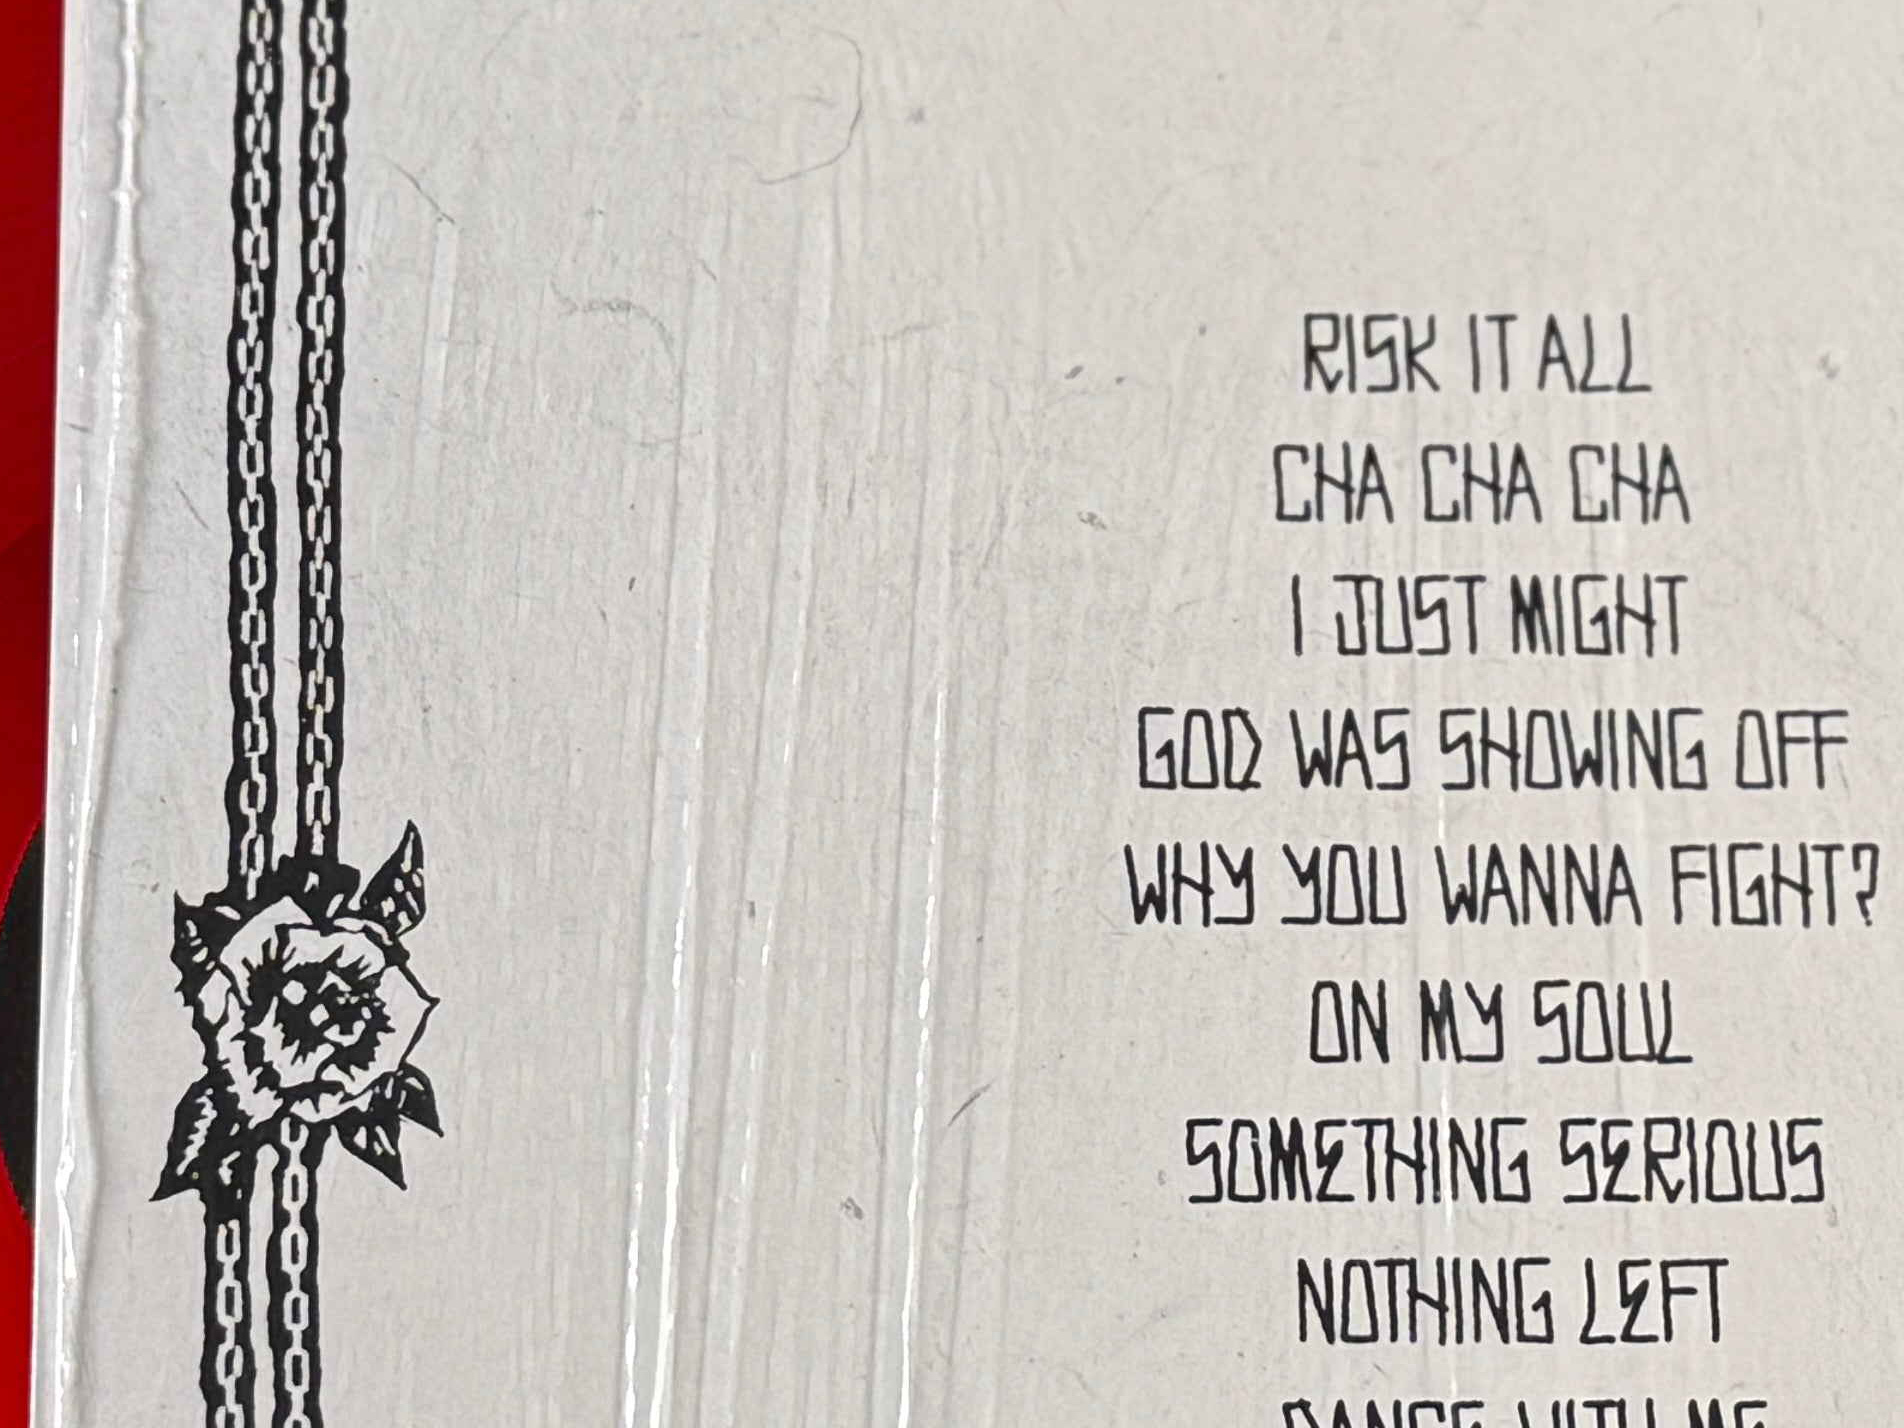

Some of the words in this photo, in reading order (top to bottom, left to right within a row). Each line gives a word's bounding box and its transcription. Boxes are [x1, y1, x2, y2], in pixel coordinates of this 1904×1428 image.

[1304, 313, 1440, 393] RISK
[1469, 314, 1517, 393] IT
[1538, 314, 1652, 393] ALL
[1273, 442, 1394, 524] CHA
[1422, 442, 1542, 524] CHA
[1570, 442, 1690, 524] CHA
[1292, 574, 1303, 656] I
[1333, 575, 1486, 656] JUST
[1511, 574, 1687, 657] MIGHT
[1138, 707, 1262, 791] GOD
[1290, 708, 1410, 790] WAS
[1440, 707, 1707, 792] SHOWING
[1736, 709, 1848, 789] OFF
[1124, 841, 1254, 927] WHY
[1281, 844, 1406, 925] YOU
[1435, 844, 1642, 927] WANNA
[1670, 842, 1879, 928] FIGHT?
[1310, 979, 1389, 1063] ON
[1420, 979, 1504, 1063] MY
[1534, 979, 1693, 1064] SOUL
[1186, 1116, 1531, 1205] SOMETHING
[1560, 1117, 1824, 1203] SERIOUS
[1298, 1257, 1554, 1346] NOTHING
[1580, 1258, 1729, 1345] LEFT
